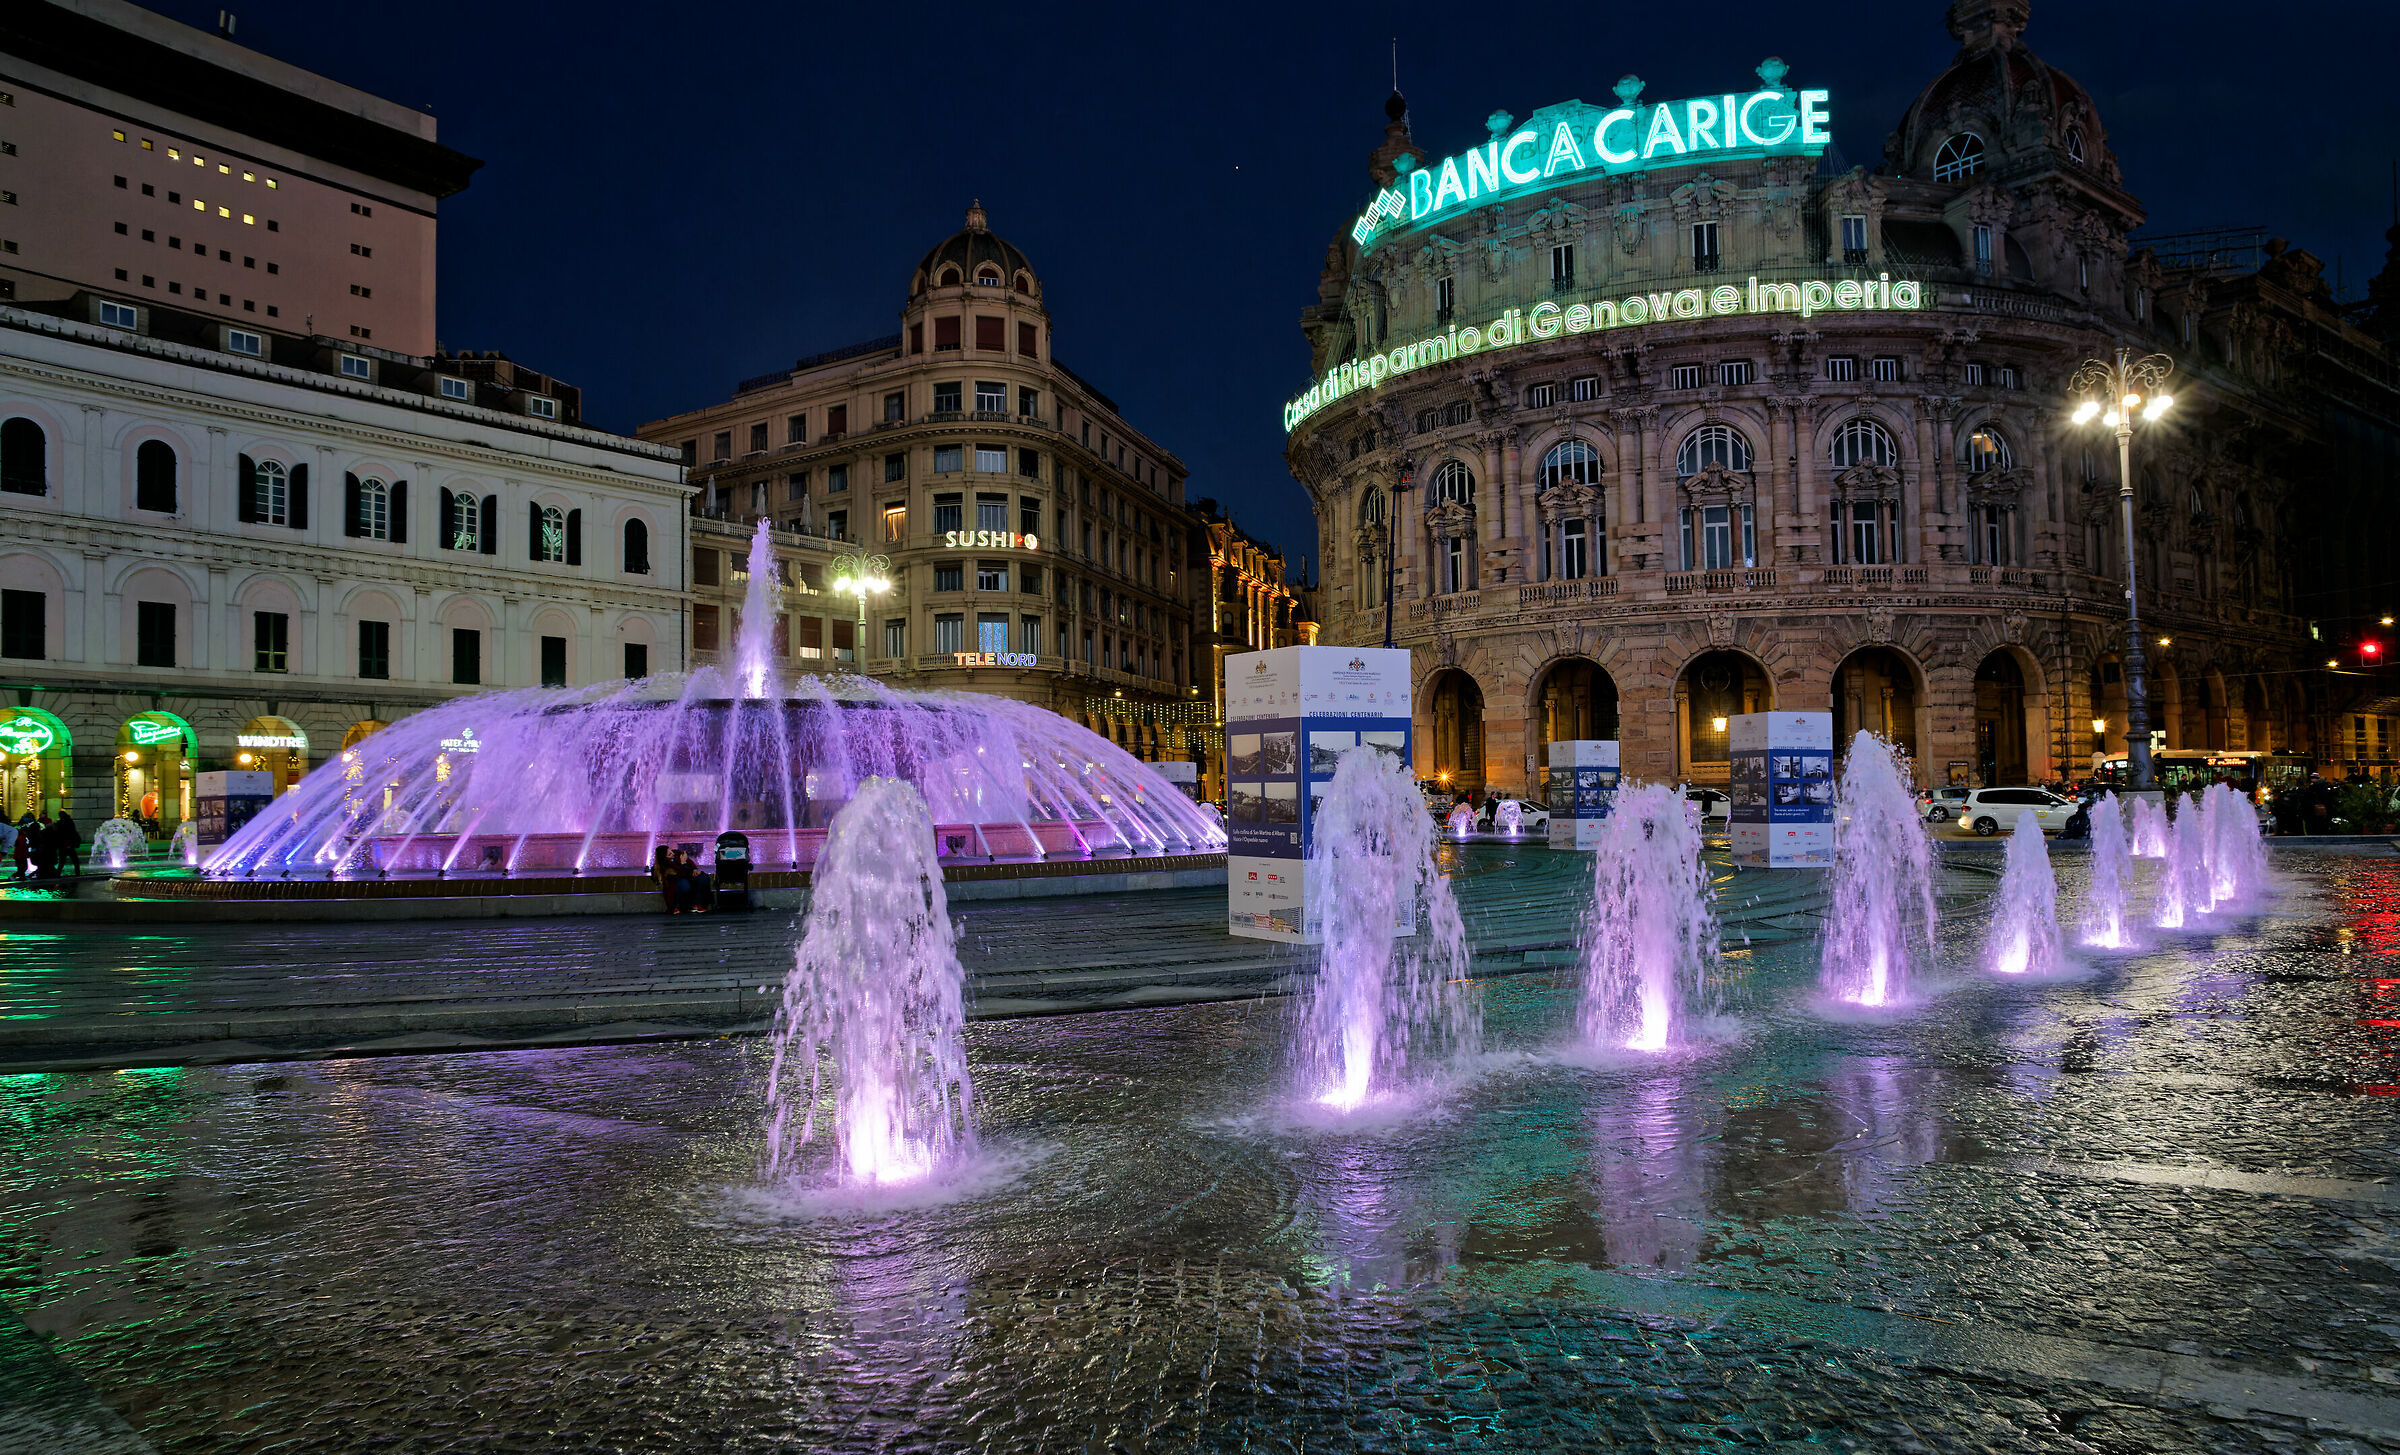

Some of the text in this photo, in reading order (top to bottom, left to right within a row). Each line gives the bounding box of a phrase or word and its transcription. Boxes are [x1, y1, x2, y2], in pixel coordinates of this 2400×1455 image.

[1410, 90, 1831, 220] BANCA CARIGE
[1284, 272, 1920, 432] Cassa di Risparmio di Genova e Imperia
[945, 530, 1015, 548] SUSHI
[237, 735, 306, 748] WINDTRE
